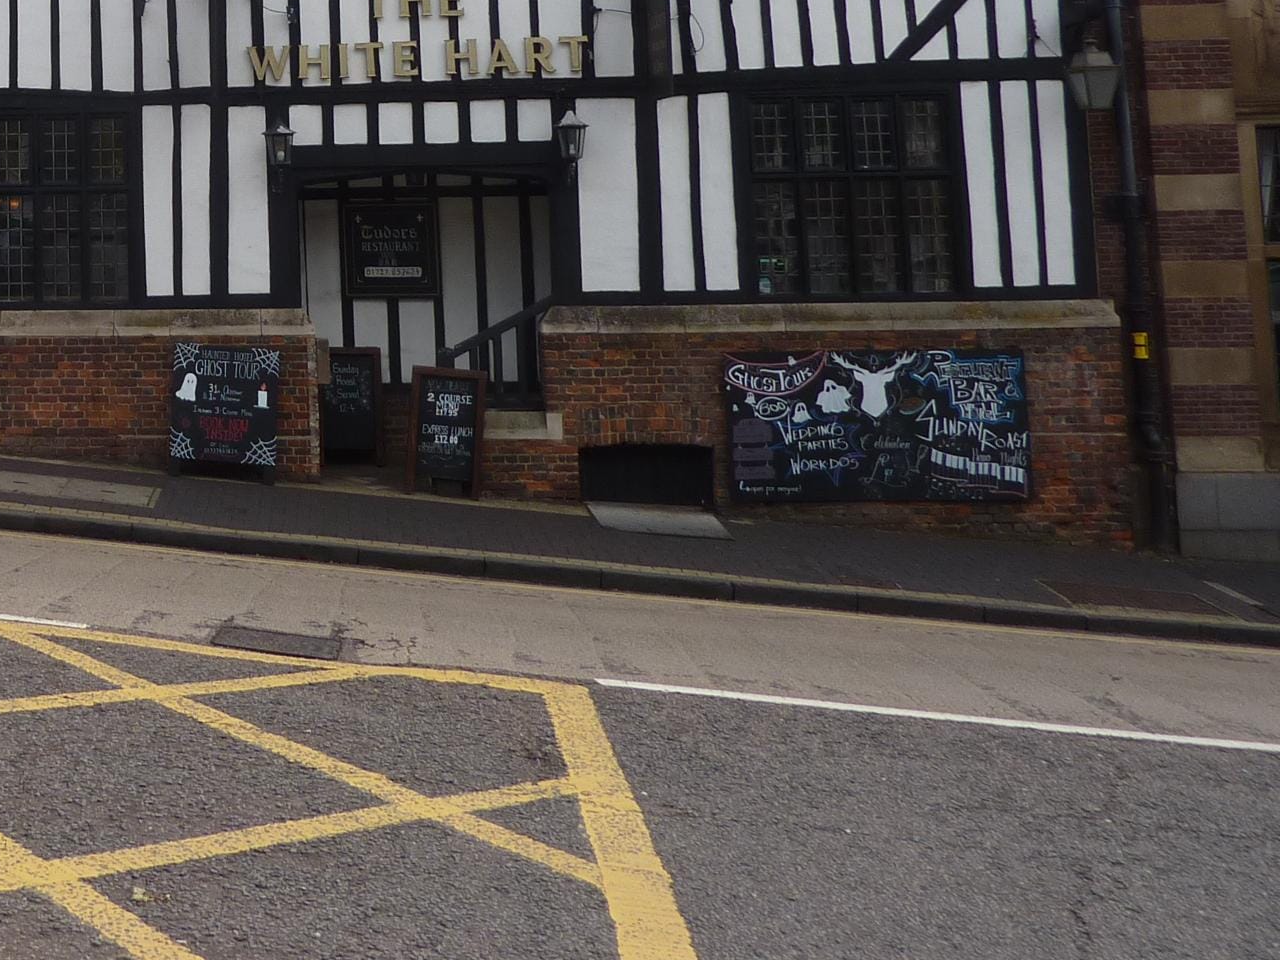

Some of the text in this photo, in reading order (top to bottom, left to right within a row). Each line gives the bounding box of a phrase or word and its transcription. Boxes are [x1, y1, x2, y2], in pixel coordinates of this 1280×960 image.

[247, 35, 589, 81] WHITE HART
[360, 224, 417, 240] Tudors
[361, 241, 420, 252] RESTAURANT
[201, 350, 254, 361] HAUNTED HOTEL
[195, 360, 260, 380] GHOST TOUR
[332, 362, 359, 376] Sunday
[950, 377, 1003, 405] BAR
[426, 392, 473, 405] 2 COURSE
[435, 401, 460, 411] MENU
[758, 401, 787, 416] BOO
[422, 424, 473, 437] EXPRESS LUNCH
[777, 417, 845, 446] WEDDINGS
[915, 399, 1028, 452] SUNDAY ROAST
[798, 438, 849, 452] PARTIES
